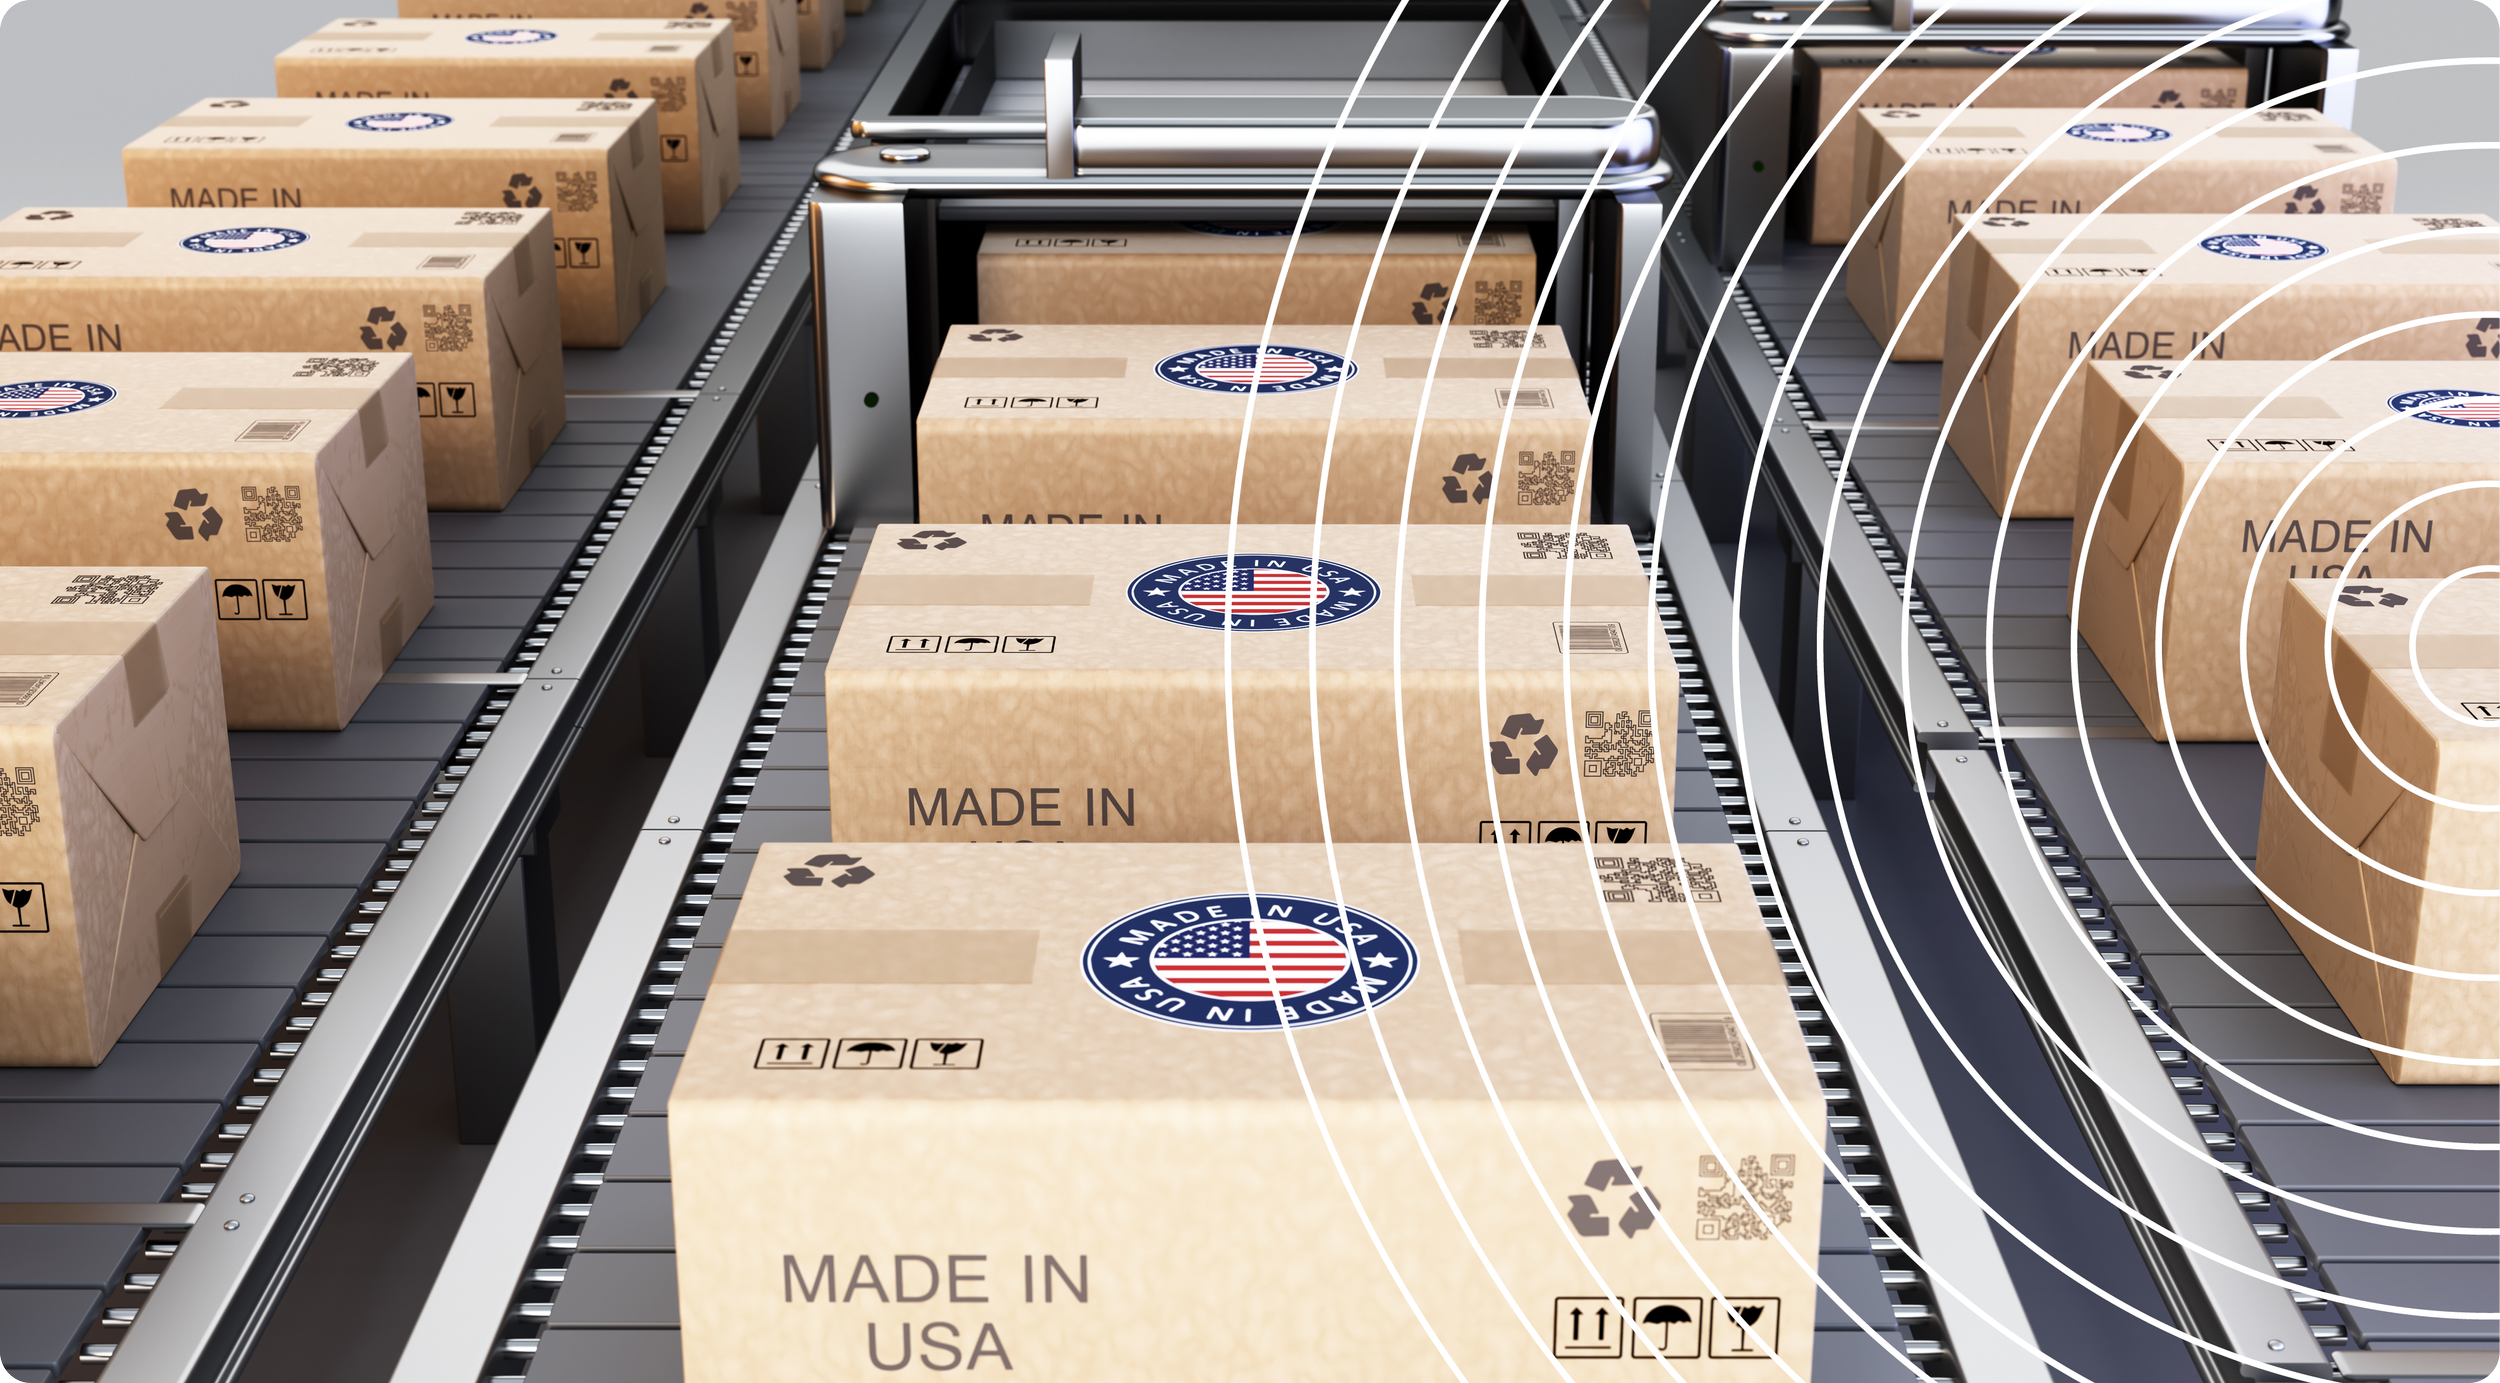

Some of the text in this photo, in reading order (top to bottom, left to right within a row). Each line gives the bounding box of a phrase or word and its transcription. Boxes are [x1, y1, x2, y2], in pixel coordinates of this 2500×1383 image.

[272, 187, 302, 208] IN
[87, 324, 122, 351] IN
[2068, 331, 2226, 359] MADE IN
[1176, 347, 1243, 365] MADE
[1294, 350, 1335, 365] USA
[1177, 374, 1218, 389] USA
[1271, 374, 1339, 392] MADE
[2241, 519, 2434, 553] MADE IN
[1254, 559, 1287, 568] IN
[1301, 565, 1351, 584] USA
[1156, 600, 1207, 622] USA
[907, 787, 1135, 827] MADE IN
[1118, 904, 1228, 946] MADE
[1312, 911, 1379, 946] USA
[1119, 975, 1187, 1013] USA
[1206, 1006, 1252, 1023] IN
[783, 1254, 1089, 1303] MADE IN
[867, 1321, 1014, 1371] USA
